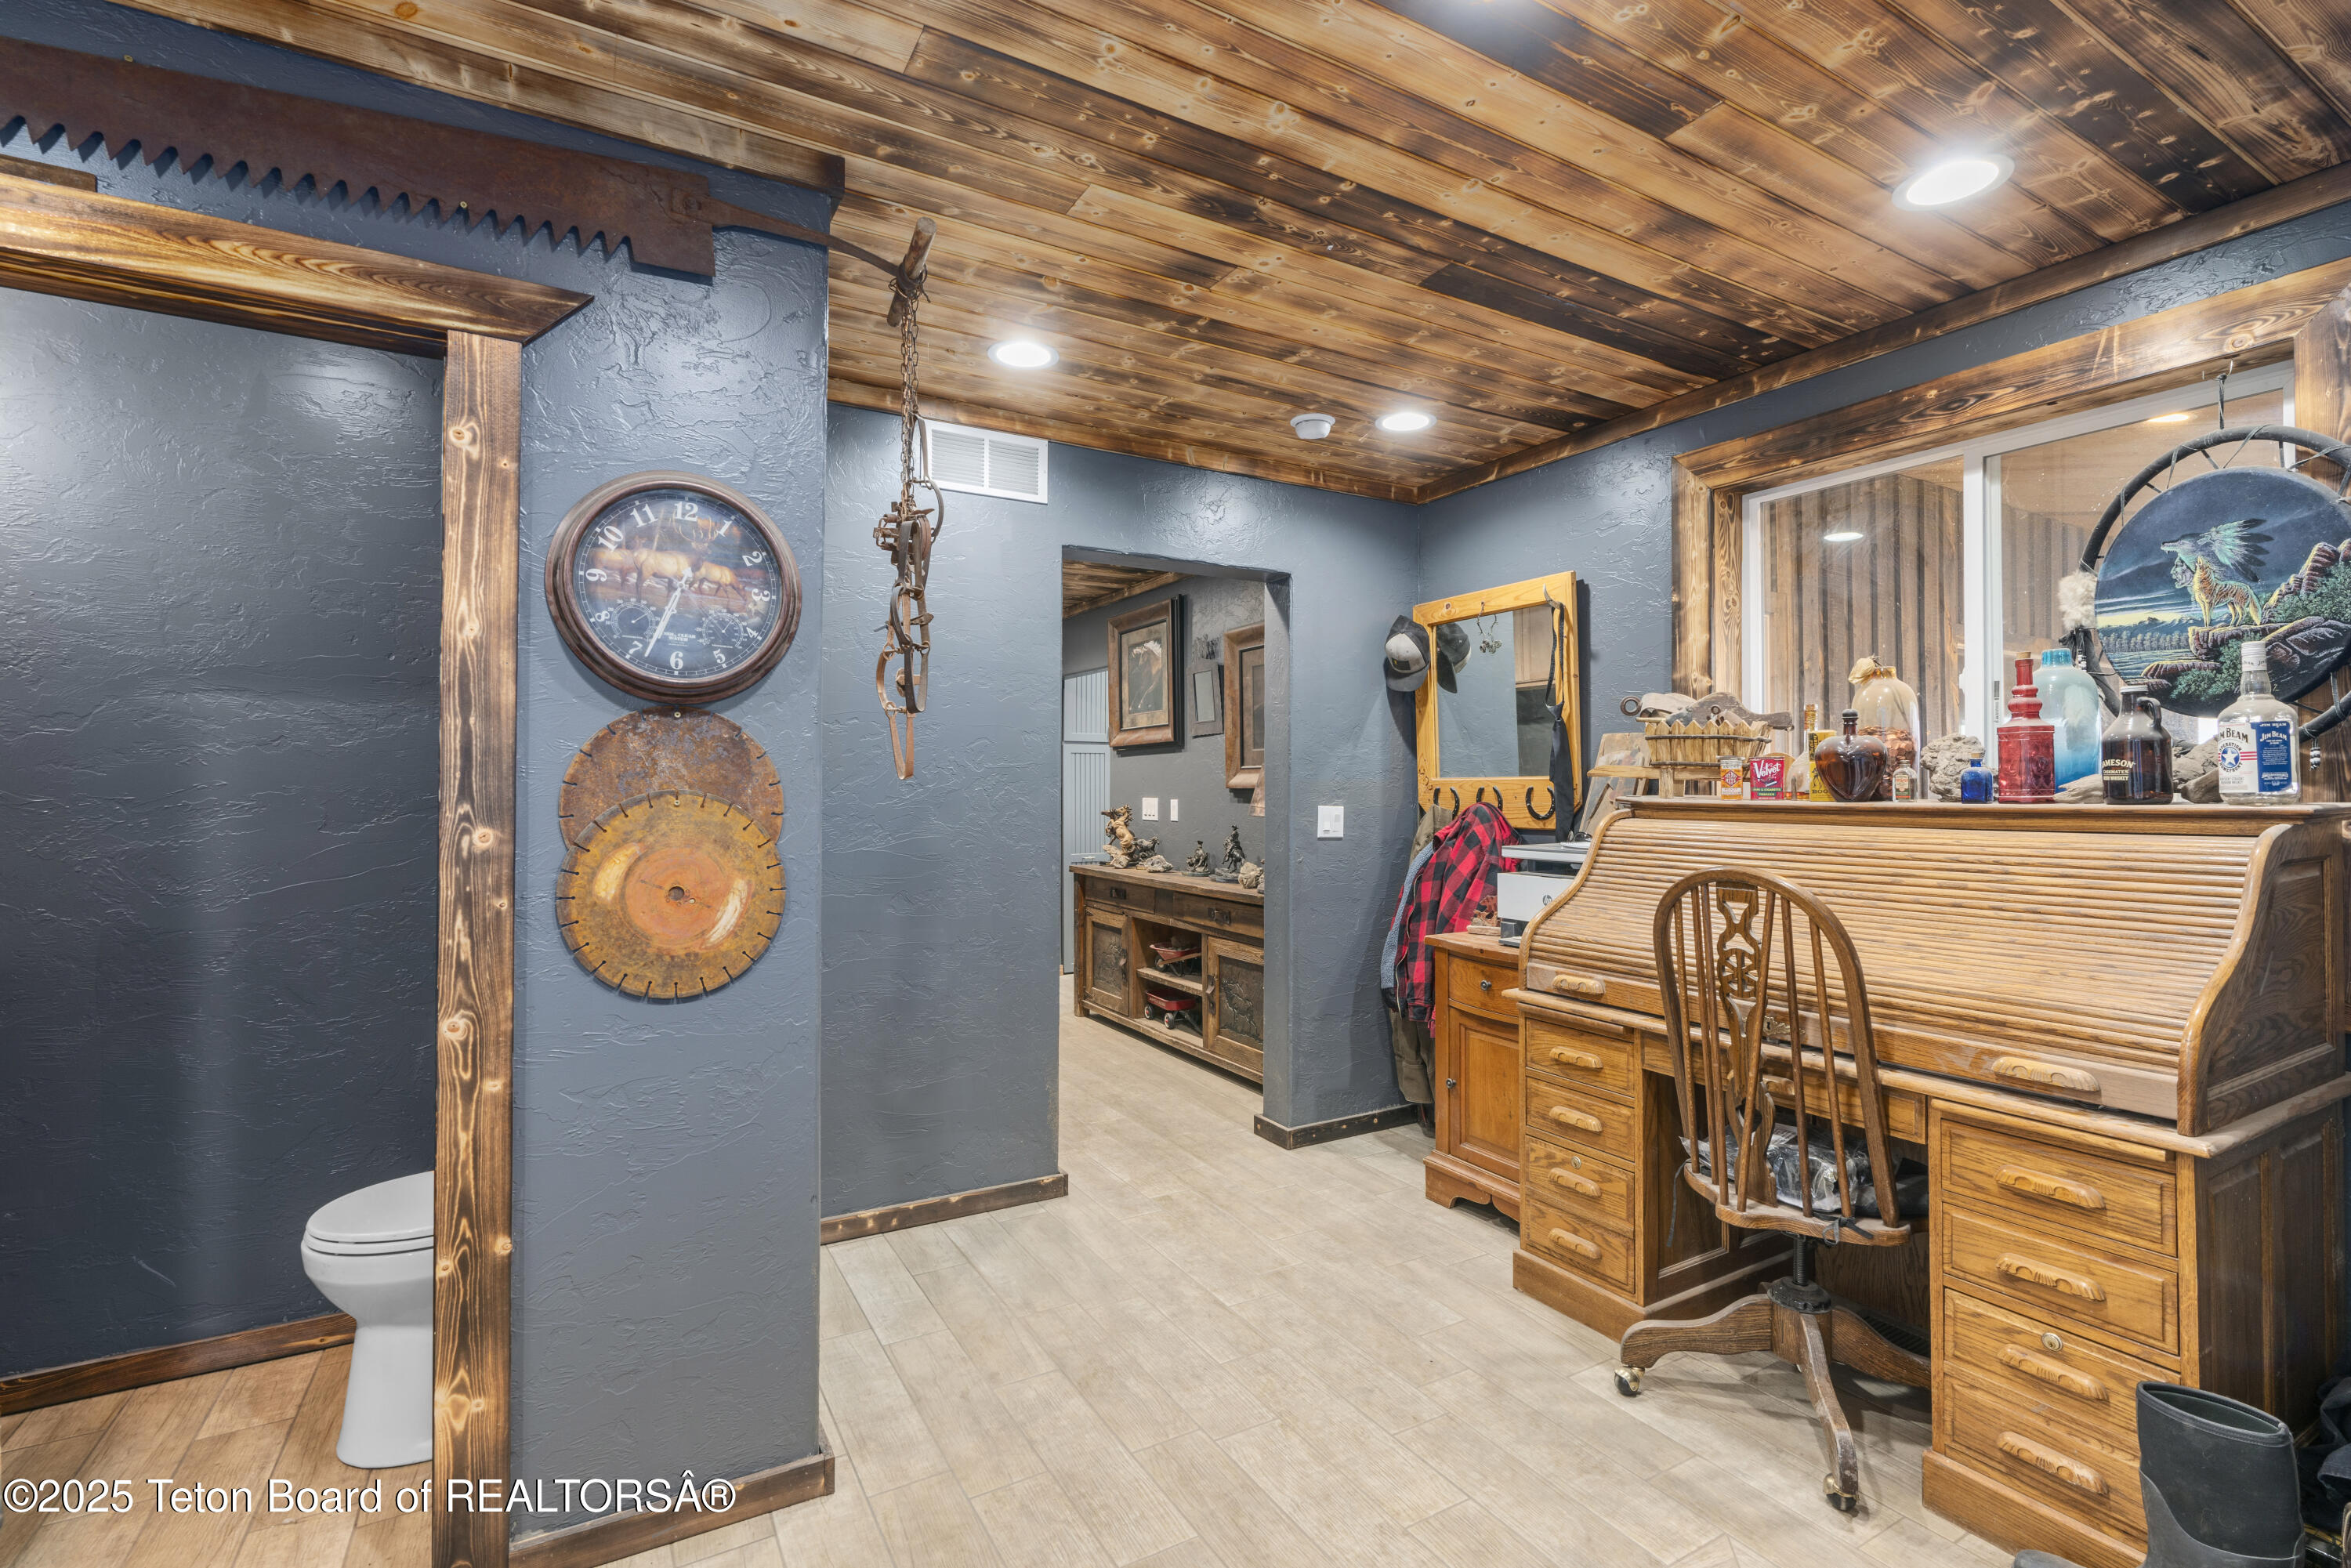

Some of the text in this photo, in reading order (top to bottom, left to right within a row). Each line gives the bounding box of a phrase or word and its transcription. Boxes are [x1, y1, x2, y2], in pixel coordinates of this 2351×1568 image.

[630, 503, 658, 527] 11
[674, 501, 698, 522] 12
[716, 520, 733, 538] 1
[598, 525, 624, 552] 10
[741, 550, 763, 567] 2
[585, 568, 607, 582] 9
[752, 588, 771, 603] 3
[595, 610, 610, 622] 8
[746, 626, 760, 639] 4
[629, 640, 643, 655] 7
[670, 651, 684, 670] 6
[713, 649, 726, 664] 5
[2226, 728, 2248, 743] BEAM
[2260, 730, 2288, 742] JIM BEAM
[2219, 742, 2242, 752] OPERATION
[1753, 760, 1781, 782] Velvet
[2102, 759, 2133, 769] AMESON
[2219, 762, 2243, 773] HOMEFRONT
